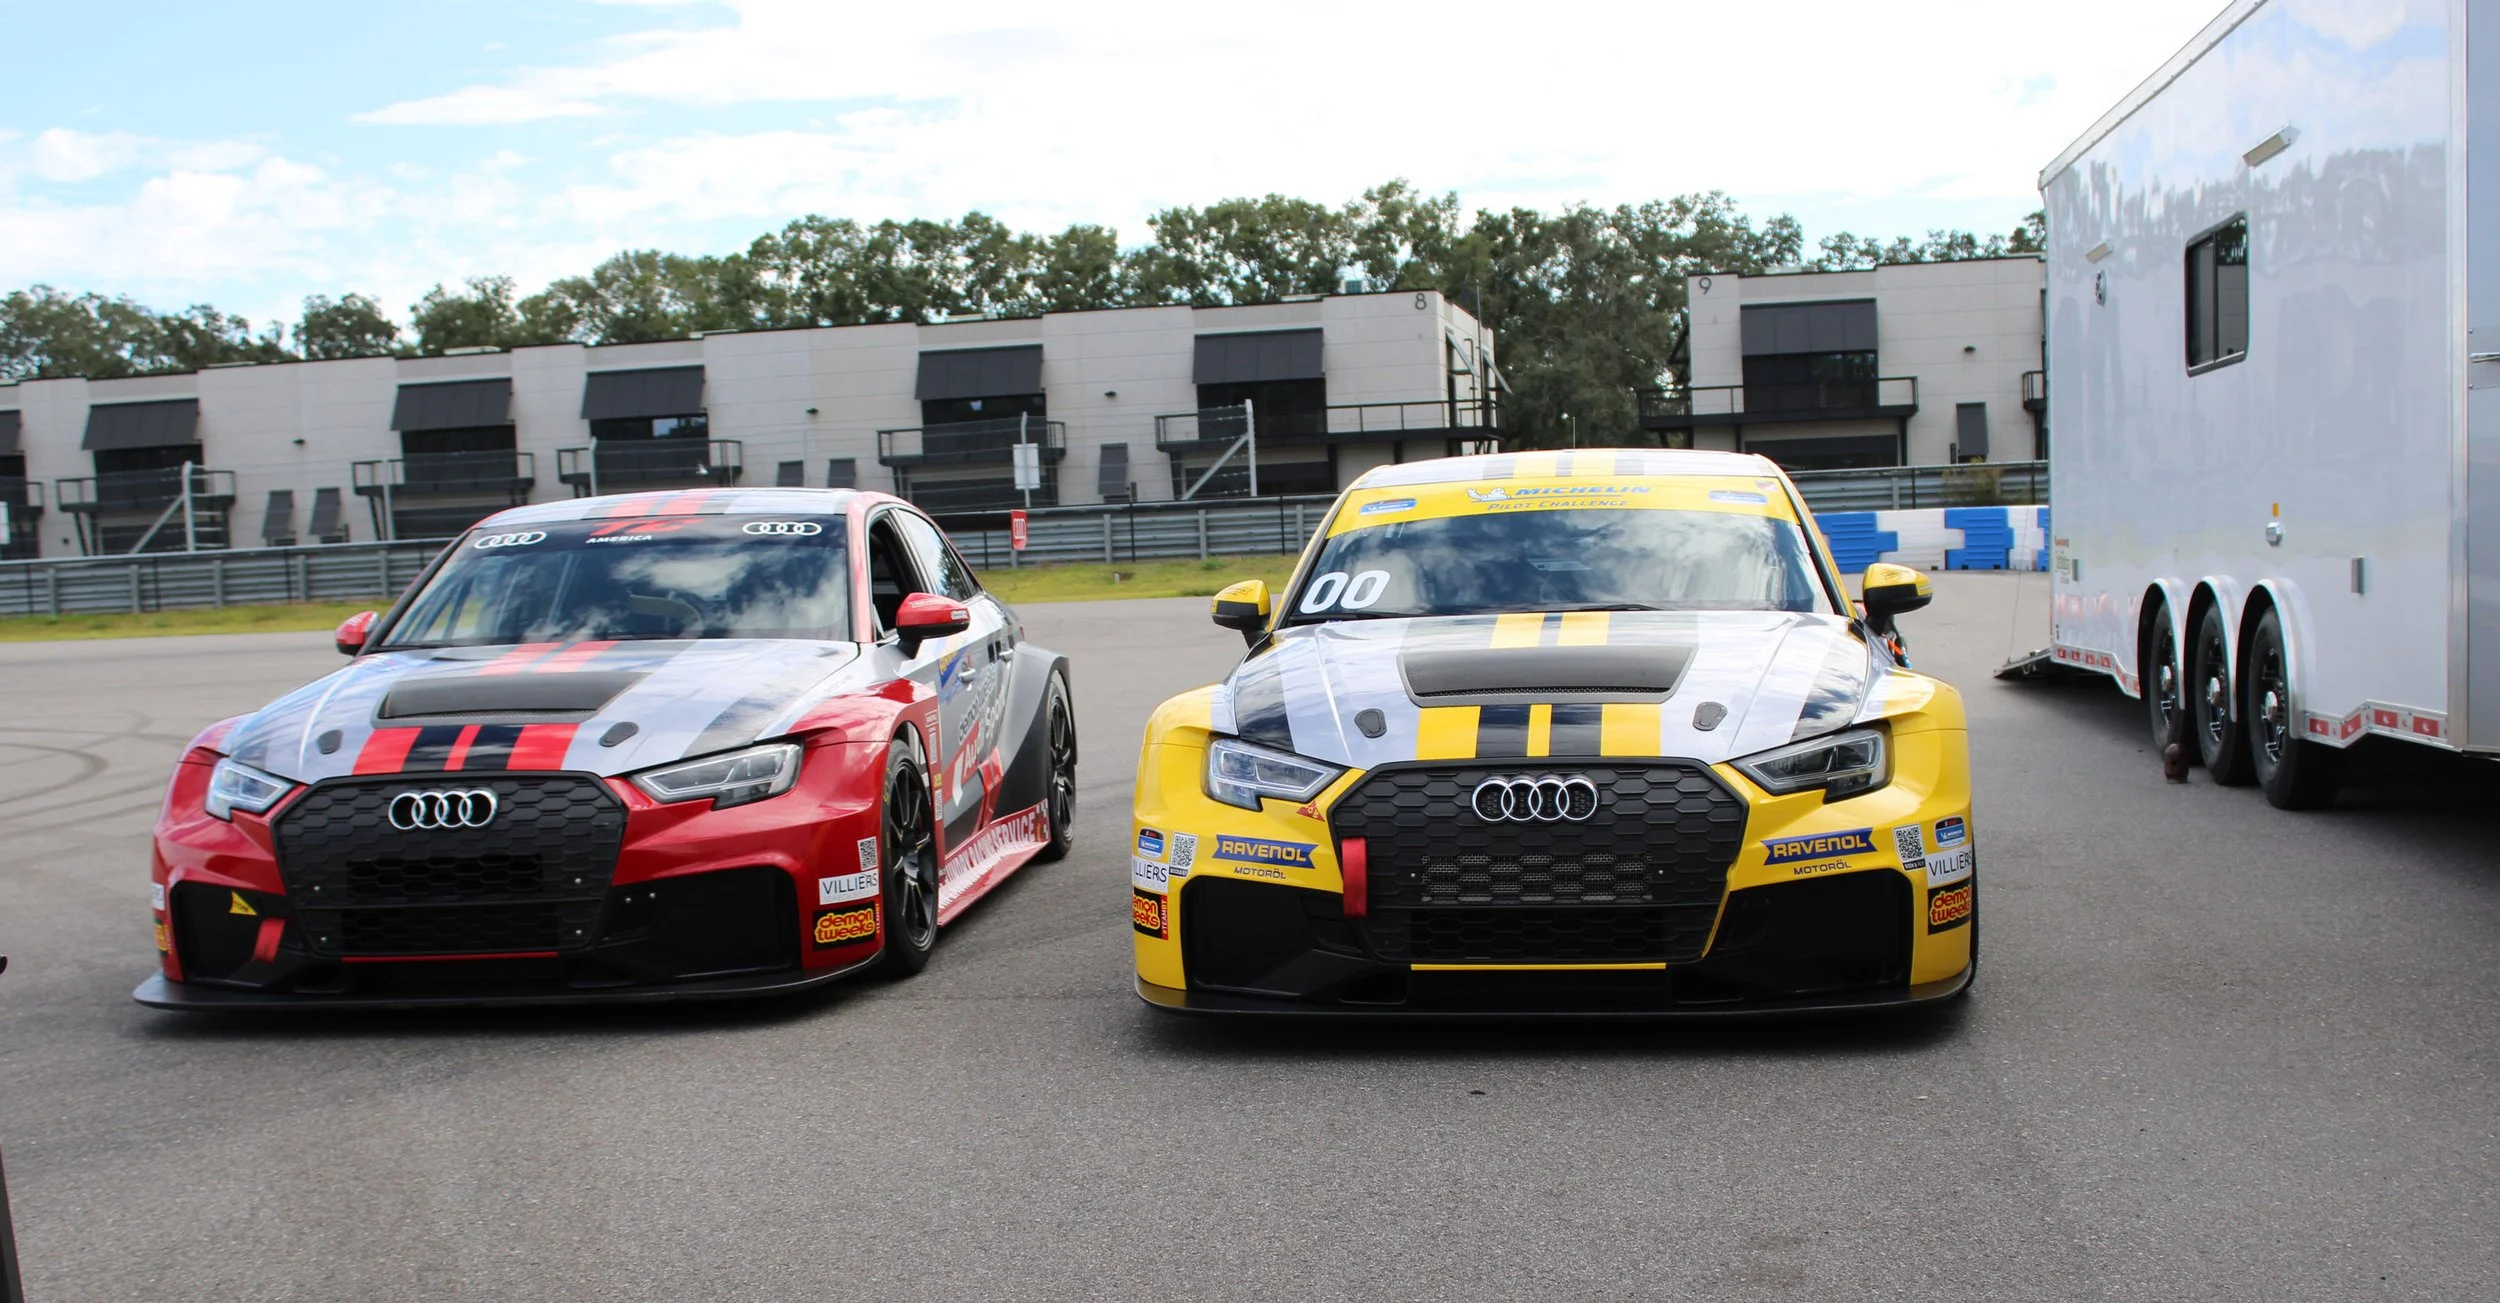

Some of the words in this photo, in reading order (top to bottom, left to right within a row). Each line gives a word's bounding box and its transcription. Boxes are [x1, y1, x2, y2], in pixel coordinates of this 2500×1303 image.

[1699, 276, 1712, 295] 9
[1415, 292, 1427, 310] 8
[1514, 486, 1650, 497] MICHELIN
[1487, 502, 1534, 511] PILOT
[1538, 500, 1629, 509] CHALLENGE
[585, 535, 653, 544] AMERICA
[1300, 569, 1391, 614] 00
[1221, 840, 1306, 862] RAVENOL
[1773, 835, 1867, 858] RAVENOL
[1234, 866, 1287, 880] MOTORÖL
[1793, 858, 1852, 876] MOTORÖL
[822, 873, 878, 895] VILLIERS
[818, 907, 874, 929] demon
[815, 920, 876, 943] tweeks
